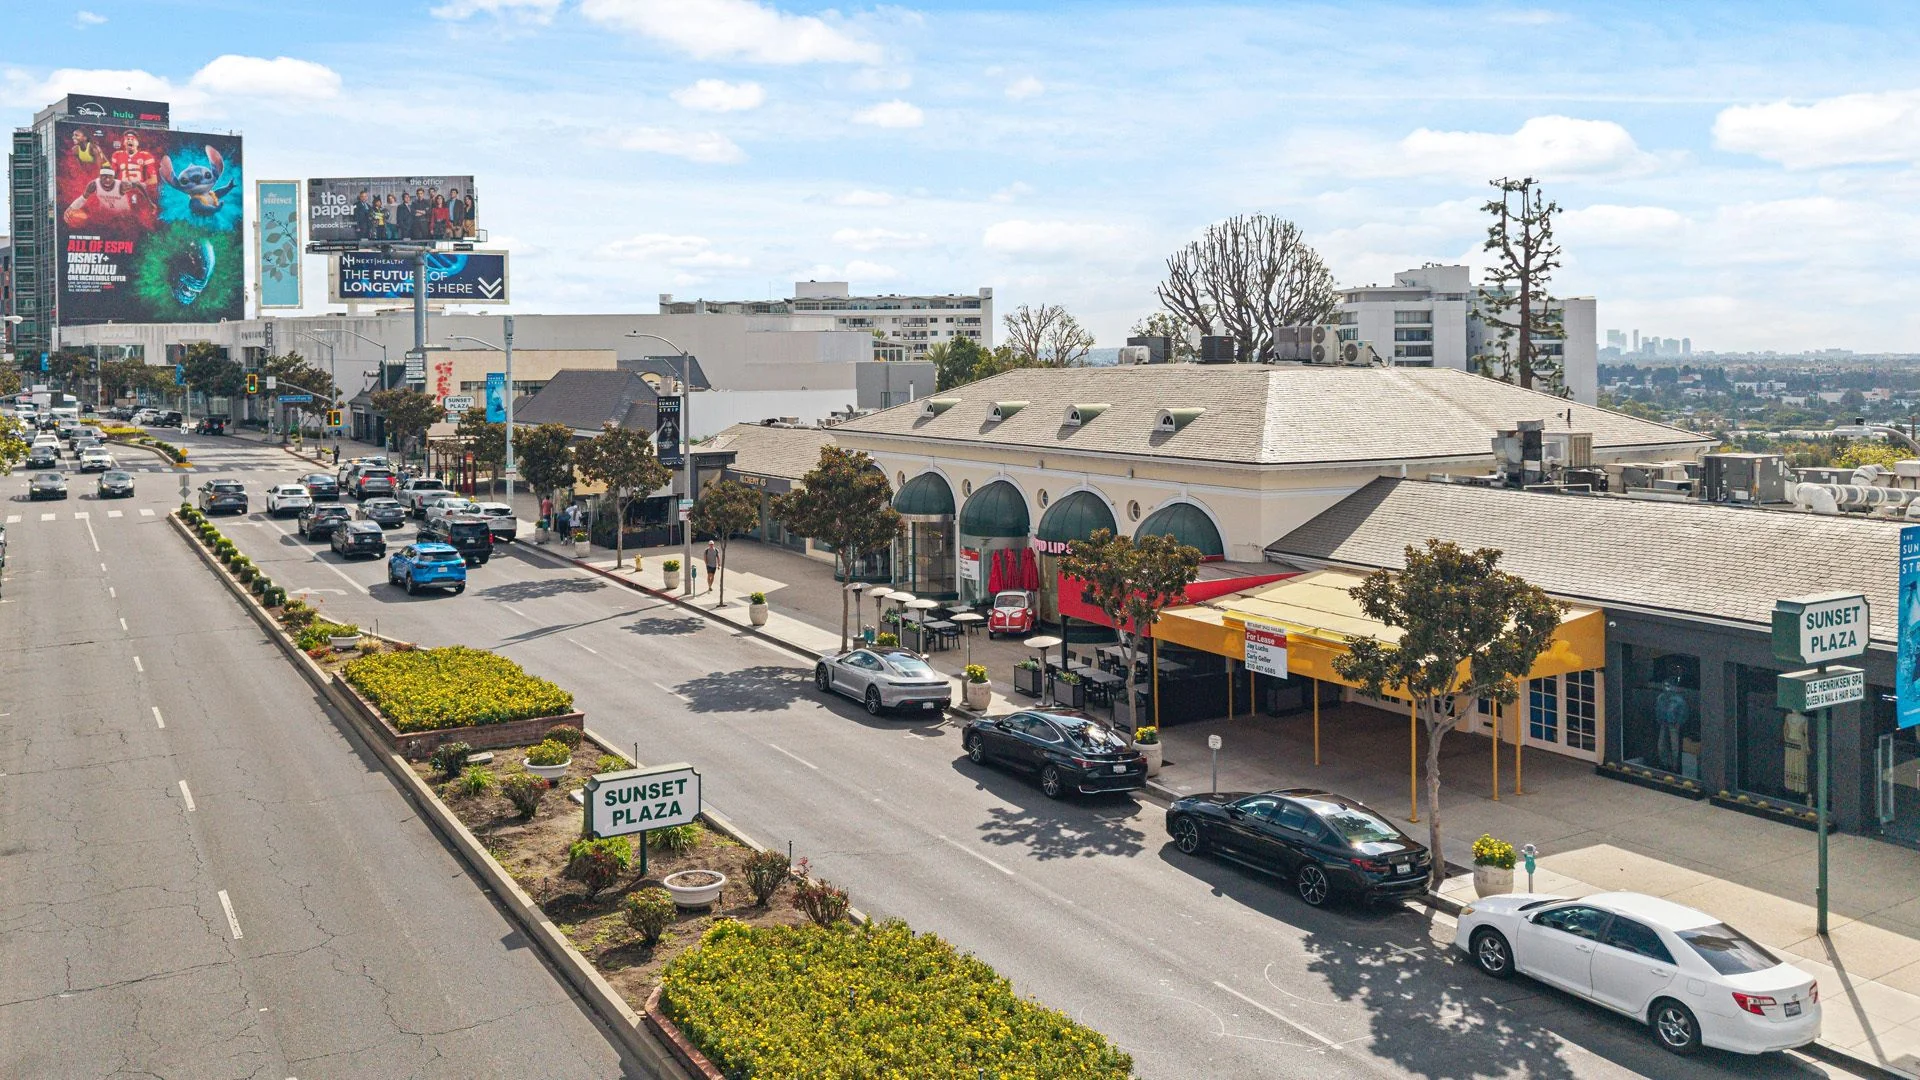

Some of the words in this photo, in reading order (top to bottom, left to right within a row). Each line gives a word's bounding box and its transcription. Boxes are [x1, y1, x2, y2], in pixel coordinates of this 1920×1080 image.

[112, 109, 134, 119] hulu
[422, 178, 444, 186] office
[320, 191, 347, 205] the
[311, 204, 357, 219] paper
[312, 222, 339, 230] peacock
[67, 240, 87, 252] ALL
[89, 240, 103, 252] OF
[104, 241, 133, 254] ESPN
[67, 252, 109, 264] DISNEY+
[67, 264, 90, 274] AND
[90, 264, 117, 275] HULU
[343, 269, 370, 280] THE
[430, 271, 448, 281] OF
[438, 284, 473, 294] HERE
[1806, 606, 1860, 630] SUNSET
[1246, 632, 1256, 640] For
[1257, 634, 1275, 645] Lease
[1811, 630, 1857, 653] PLAZA
[1806, 683, 1817, 694] OLE
[1818, 679, 1851, 692] HENRIKSEN
[1852, 675, 1863, 686] SPA
[1806, 695, 1820, 706] QUEEN
[1825, 692, 1834, 702] NAIL
[1835, 692, 1838, 700] &
[1839, 689, 1849, 700] HAIR
[1849, 686, 1863, 698] SALON
[604, 778, 688, 806] SUNSET
[612, 800, 682, 827] PLAZA
